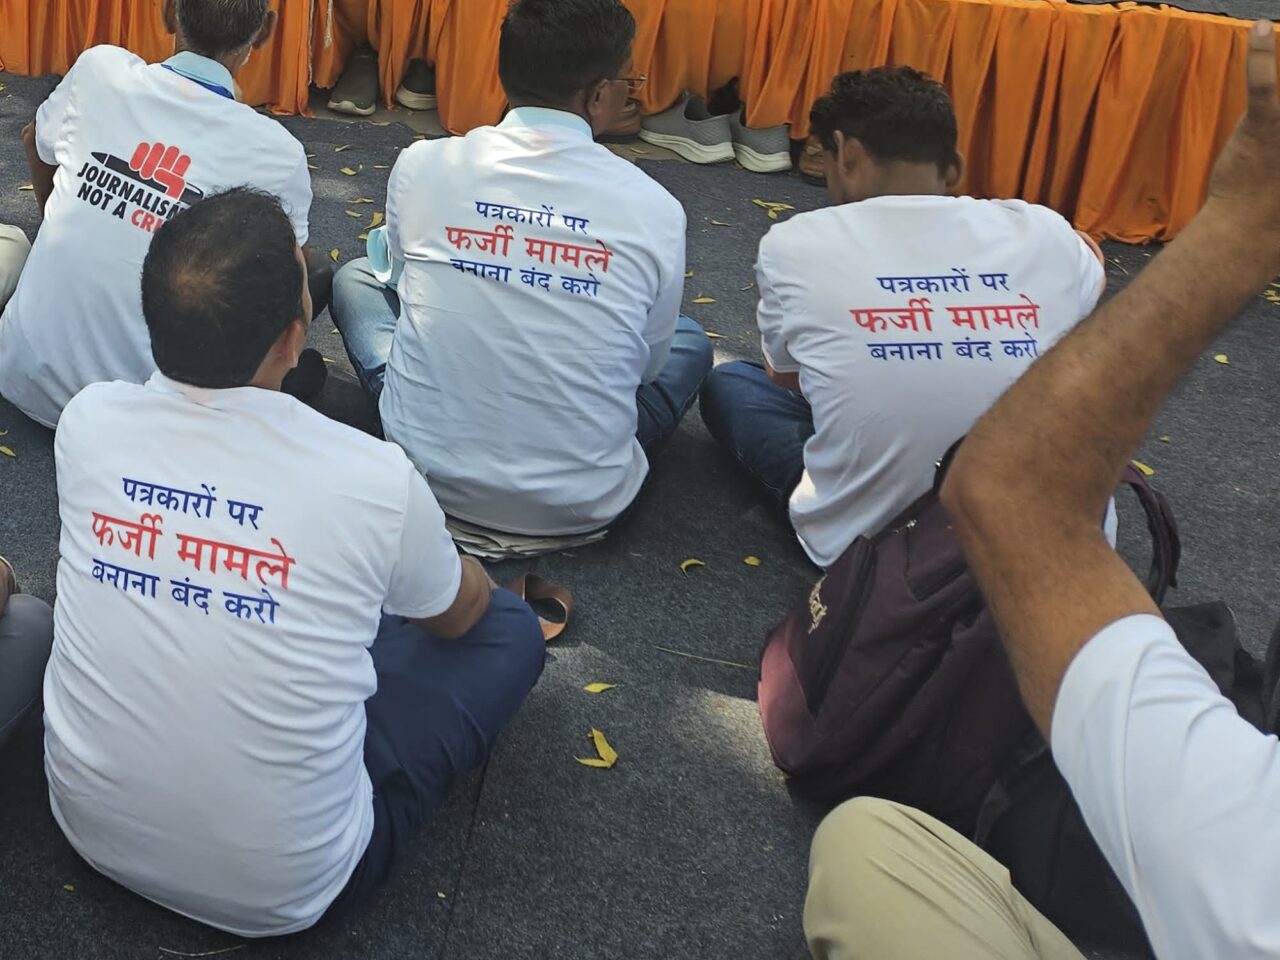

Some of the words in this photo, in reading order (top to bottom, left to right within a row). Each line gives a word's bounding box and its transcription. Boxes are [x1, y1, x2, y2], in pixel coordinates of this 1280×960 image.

[77, 183, 114, 211] NOT
[112, 199, 128, 220] A
[475, 201, 554, 228] पत्रकारों
[563, 215, 589, 234] पर
[445, 224, 514, 257] फर्जी
[524, 238, 613, 273] मामले
[450, 258, 512, 283] बनाना
[520, 266, 552, 291] बंद
[560, 273, 601, 297] करो
[876, 268, 970, 293] पत्रकारों
[978, 272, 1010, 291] पर
[849, 297, 934, 333] फर्जी
[945, 293, 1040, 331] मामले
[867, 342, 943, 360] बनाना
[952, 337, 992, 361] बंद
[1000, 332, 1040, 359] करो
[122, 478, 217, 518] पत्रकारों
[227, 499, 264, 530] पर
[92, 512, 163, 561] फर्जी
[176, 533, 296, 590] मामले
[92, 558, 160, 599] बनाना
[170, 577, 212, 615] बंद
[223, 588, 280, 624] करो
